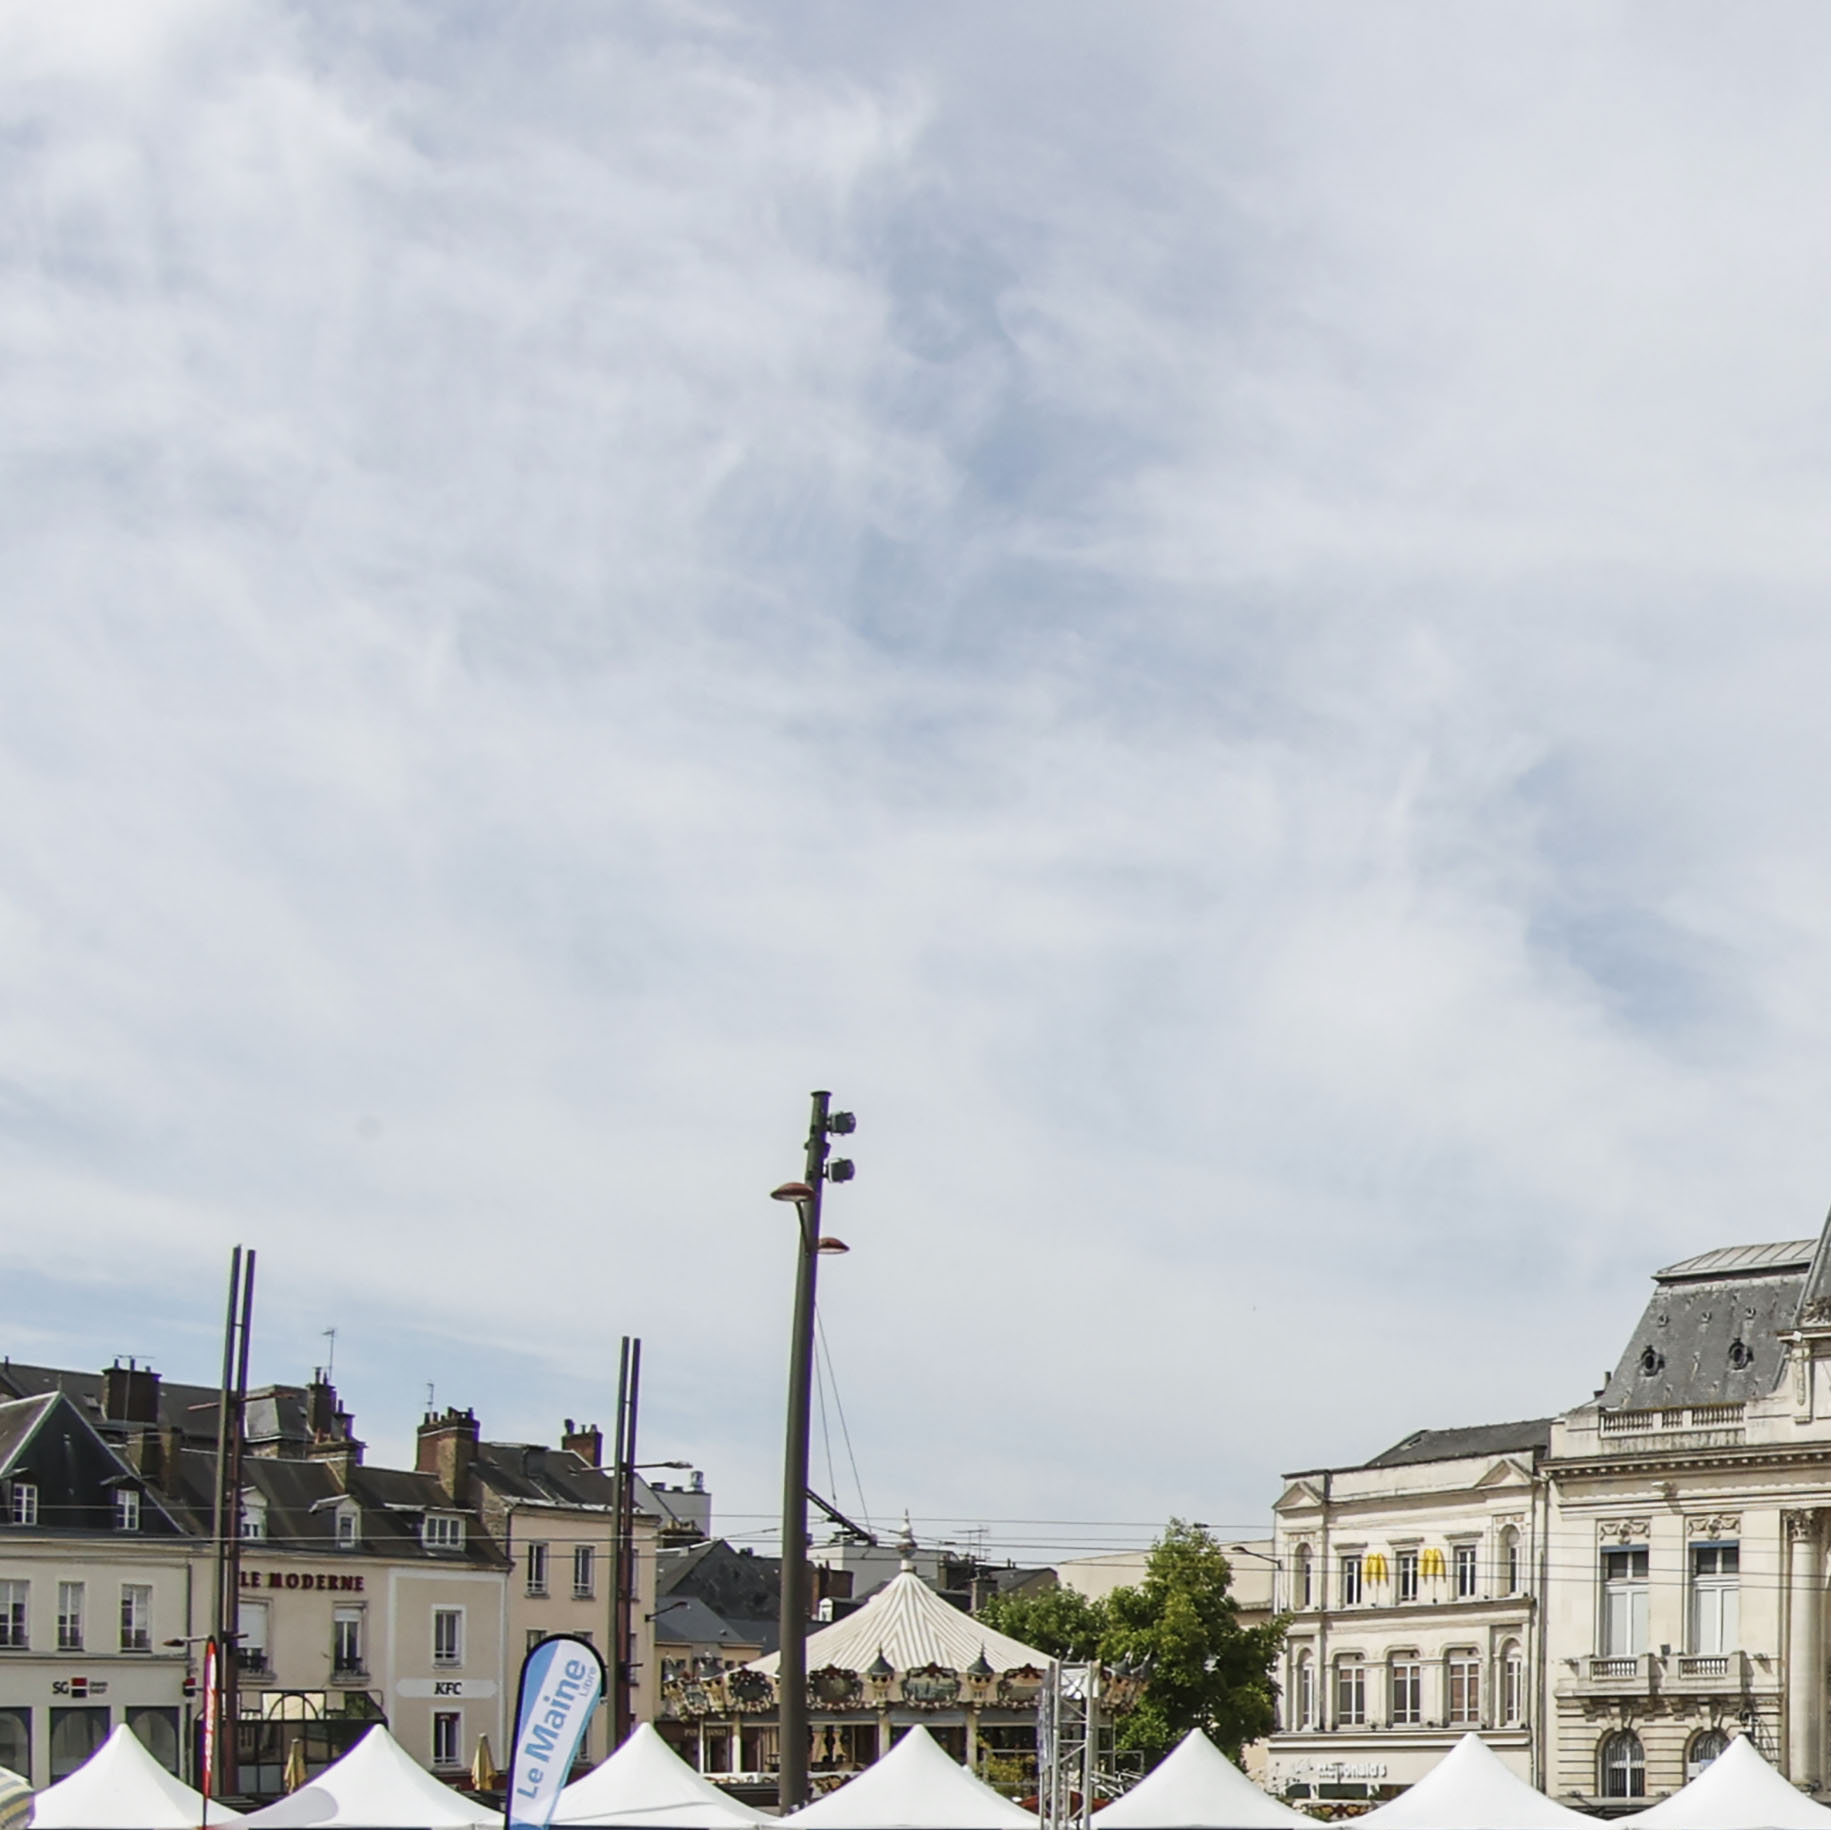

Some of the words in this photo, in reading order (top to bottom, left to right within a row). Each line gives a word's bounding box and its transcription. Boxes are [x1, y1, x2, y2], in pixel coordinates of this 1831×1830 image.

[240, 1571, 260, 1588] LE
[268, 1572, 365, 1592] MODERNE
[52, 1681, 69, 1695] SG
[434, 1682, 462, 1695] KFC
[524, 1658, 587, 1763] Maine
[516, 1765, 544, 1800] Le
